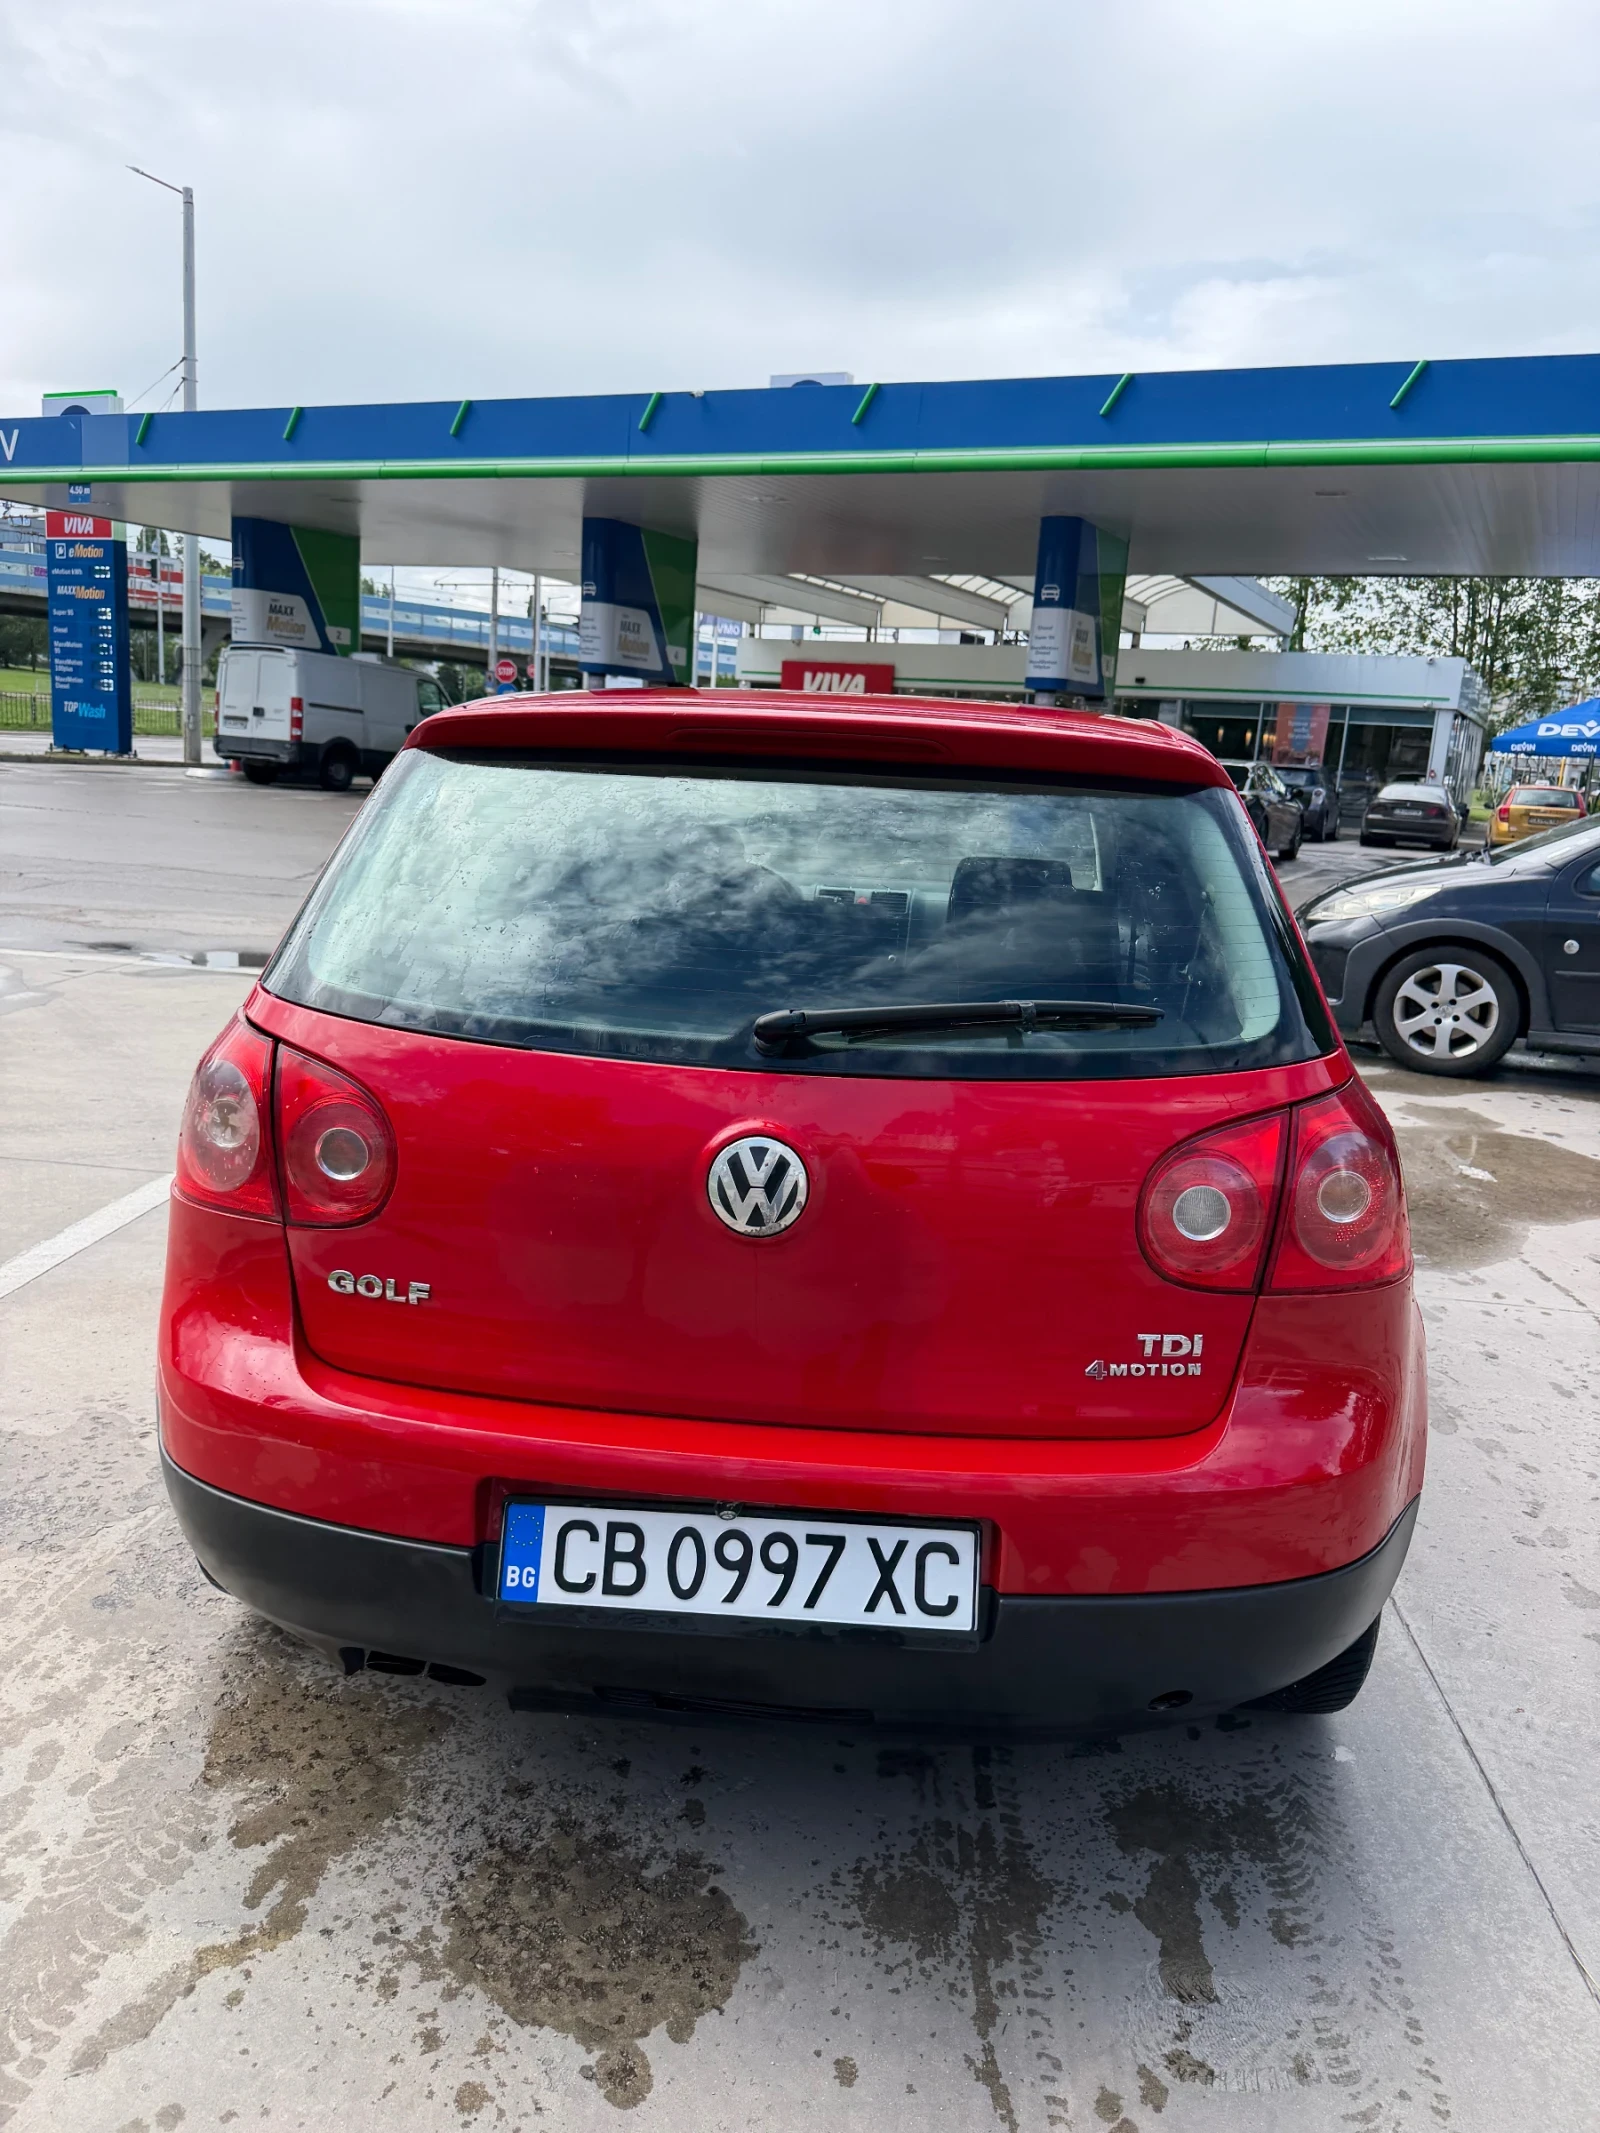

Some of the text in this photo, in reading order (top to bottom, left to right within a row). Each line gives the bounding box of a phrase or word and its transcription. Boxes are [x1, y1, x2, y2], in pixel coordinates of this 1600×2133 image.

[69, 486, 83, 494] 4.50
[64, 517, 94, 534] VIVA
[268, 603, 295, 616] MAXX
[336, 630, 342, 640] 2
[497, 667, 514, 676] STOP
[803, 671, 865, 693] VIVA
[1510, 742, 1536, 752] DEVIN
[1571, 743, 1597, 753] DEVIN
[327, 1269, 431, 1305] GOLF
[1137, 1333, 1203, 1357] TDI
[554, 1519, 960, 1617] CB 0997 XC
[506, 1566, 536, 1588] BG
